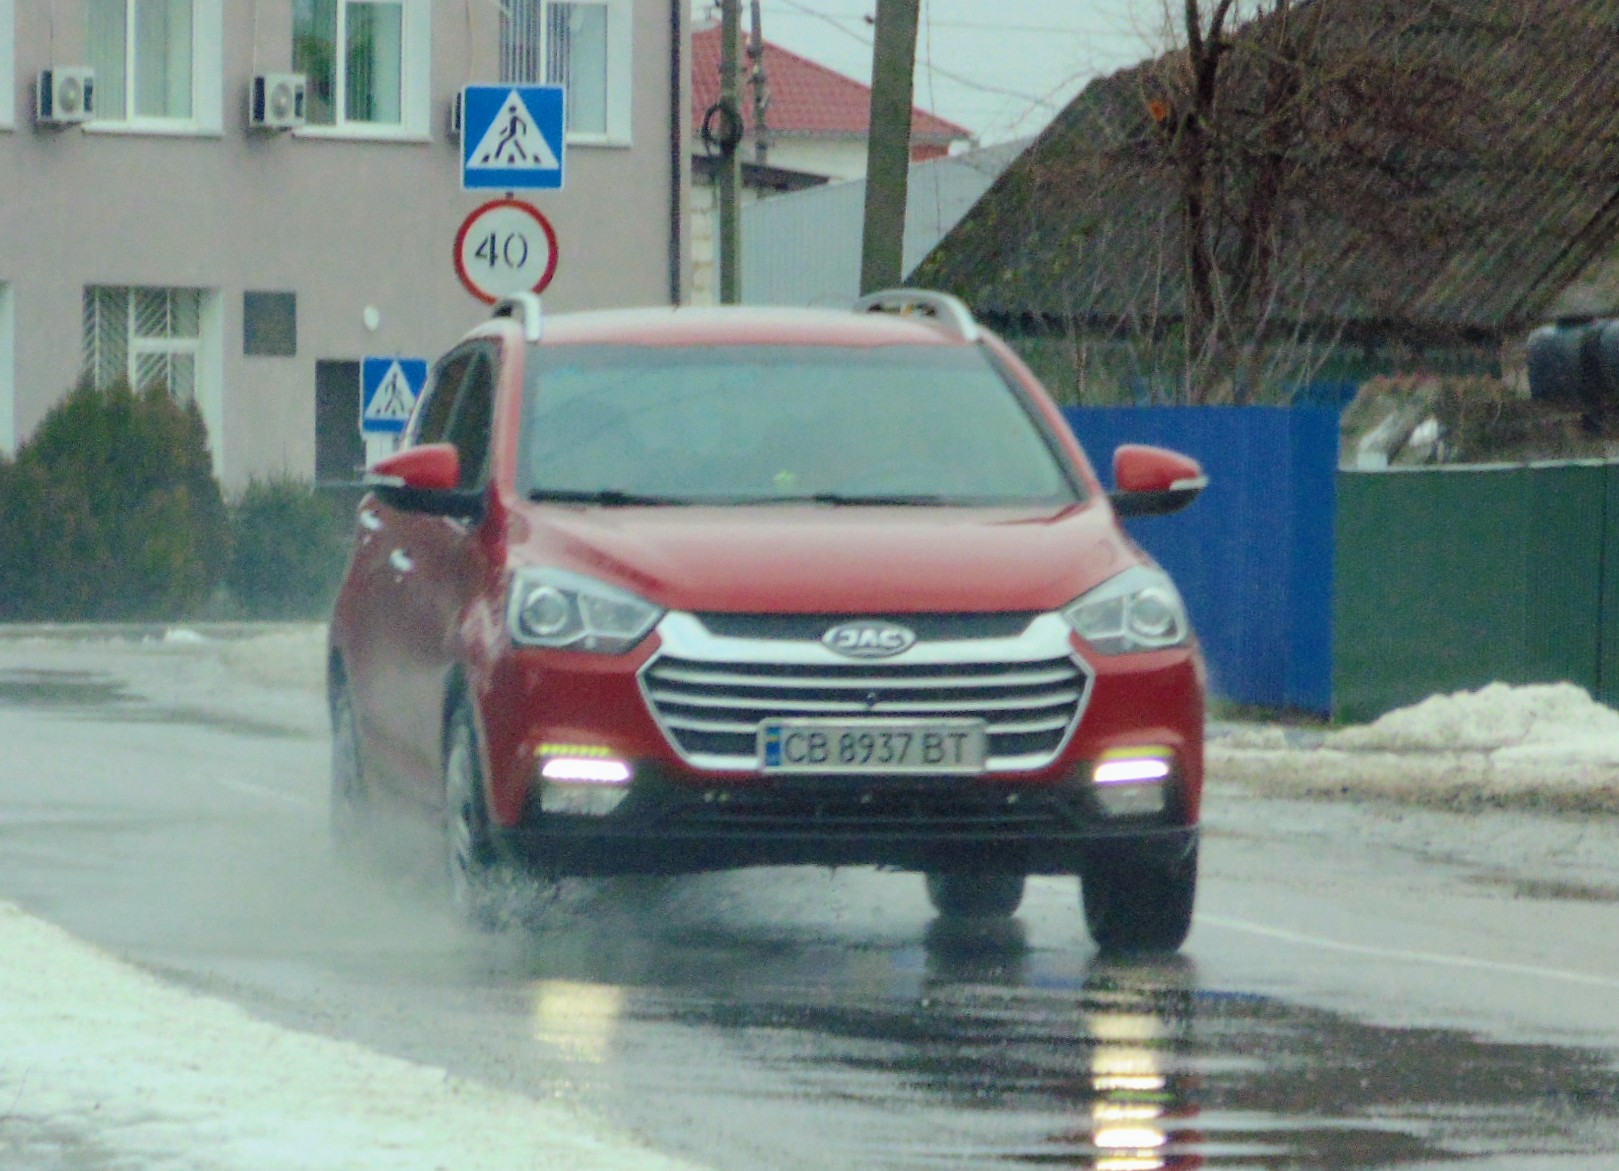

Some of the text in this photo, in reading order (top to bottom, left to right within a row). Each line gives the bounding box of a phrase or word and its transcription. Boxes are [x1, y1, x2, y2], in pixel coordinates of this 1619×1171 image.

[475, 232, 528, 269] 40
[837, 628, 904, 649] JAC
[784, 732, 969, 764] CB 8937 BT
